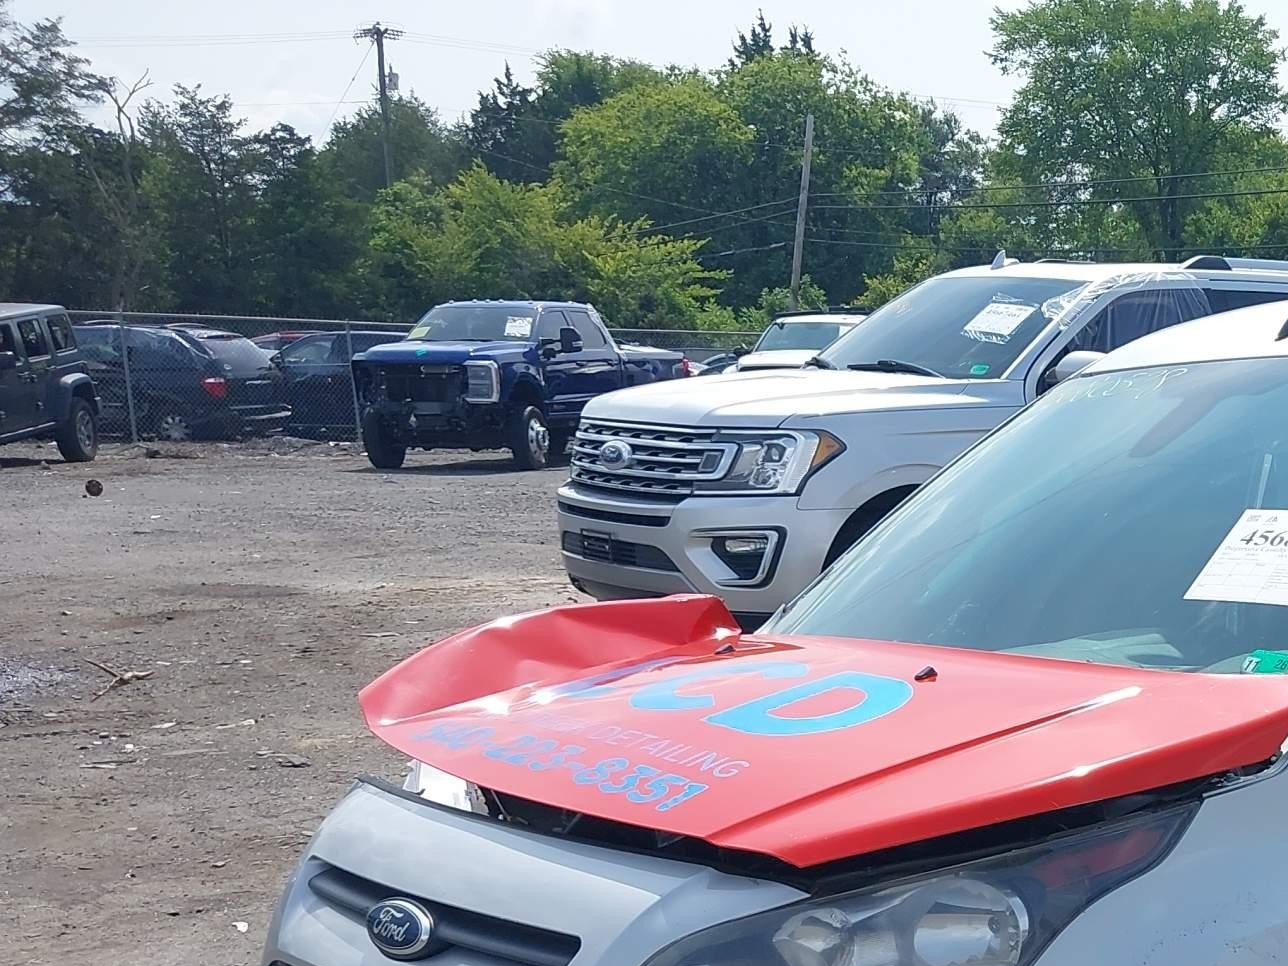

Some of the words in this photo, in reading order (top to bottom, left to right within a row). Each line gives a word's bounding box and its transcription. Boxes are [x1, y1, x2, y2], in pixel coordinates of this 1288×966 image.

[1244, 660, 1260, 672] 11
[584, 724, 750, 778] DETAILING
[373, 907, 410, 941] Ford
